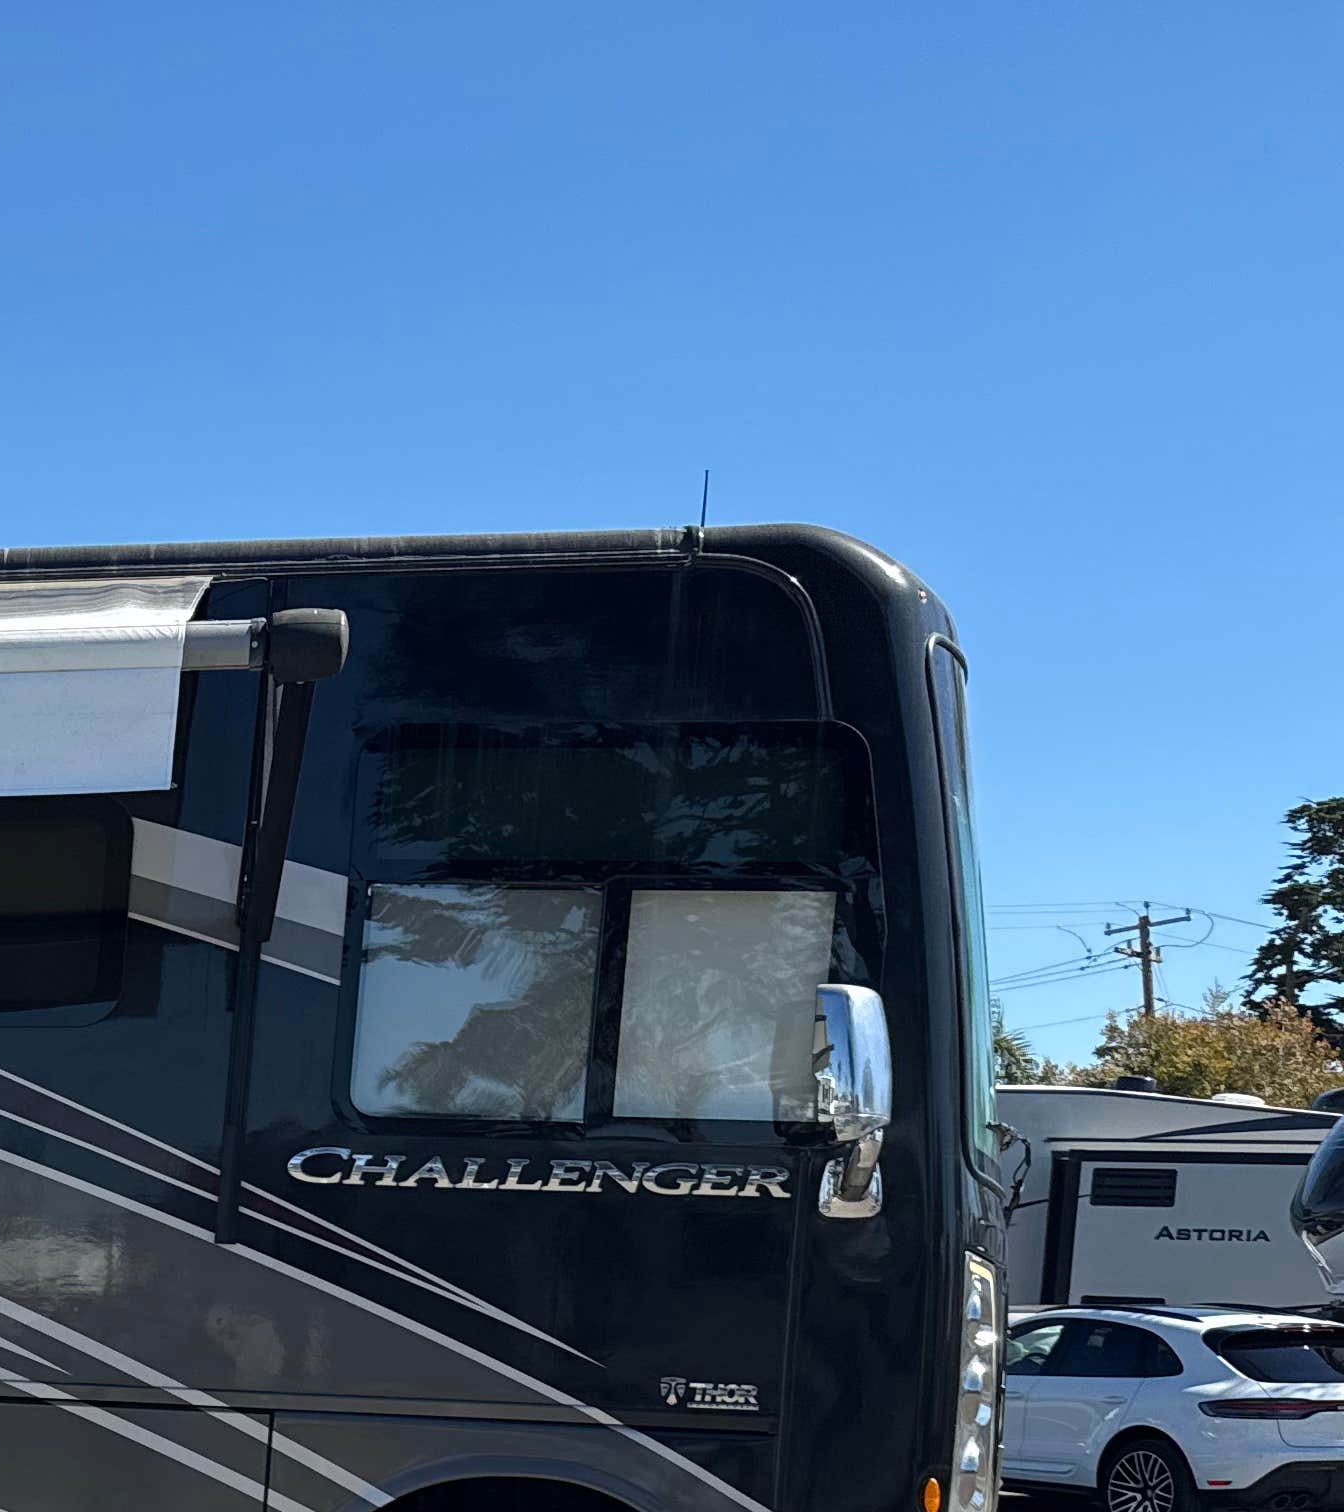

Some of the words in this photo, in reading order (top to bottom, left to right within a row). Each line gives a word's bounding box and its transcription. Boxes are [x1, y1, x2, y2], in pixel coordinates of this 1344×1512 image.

[286, 1146, 791, 1198] CHALLENGER
[1154, 1226, 1271, 1242] ASTORIA
[689, 1382, 759, 1405] THOR
